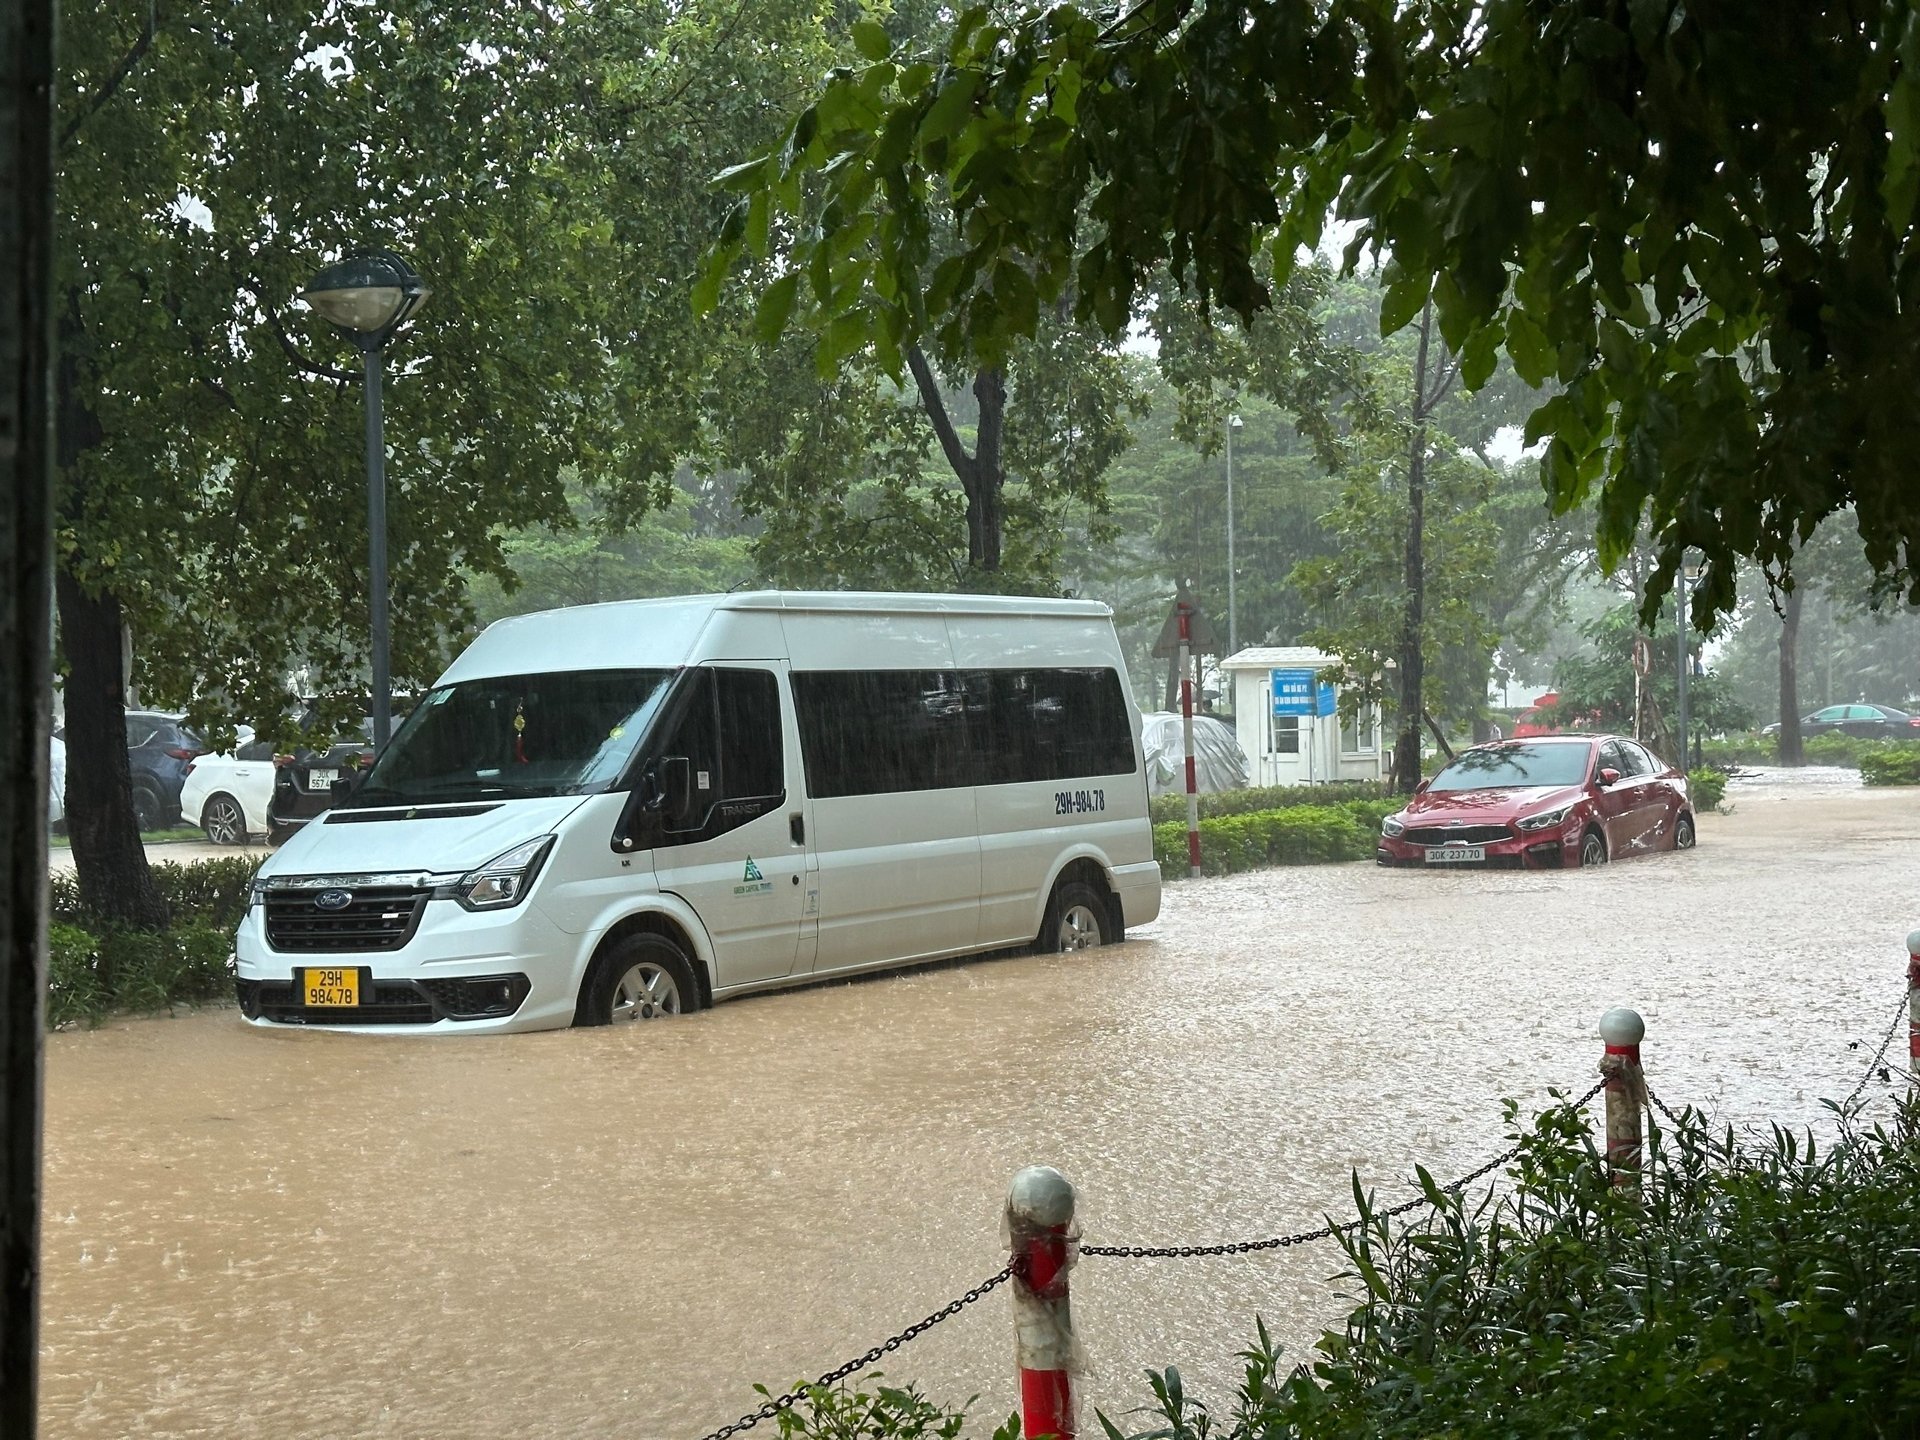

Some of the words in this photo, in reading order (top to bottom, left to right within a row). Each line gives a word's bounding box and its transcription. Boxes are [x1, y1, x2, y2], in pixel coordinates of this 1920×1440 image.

[321, 893, 342, 904] Ford
[319, 971, 343, 987] 29H
[310, 988, 353, 1005] 984.78
